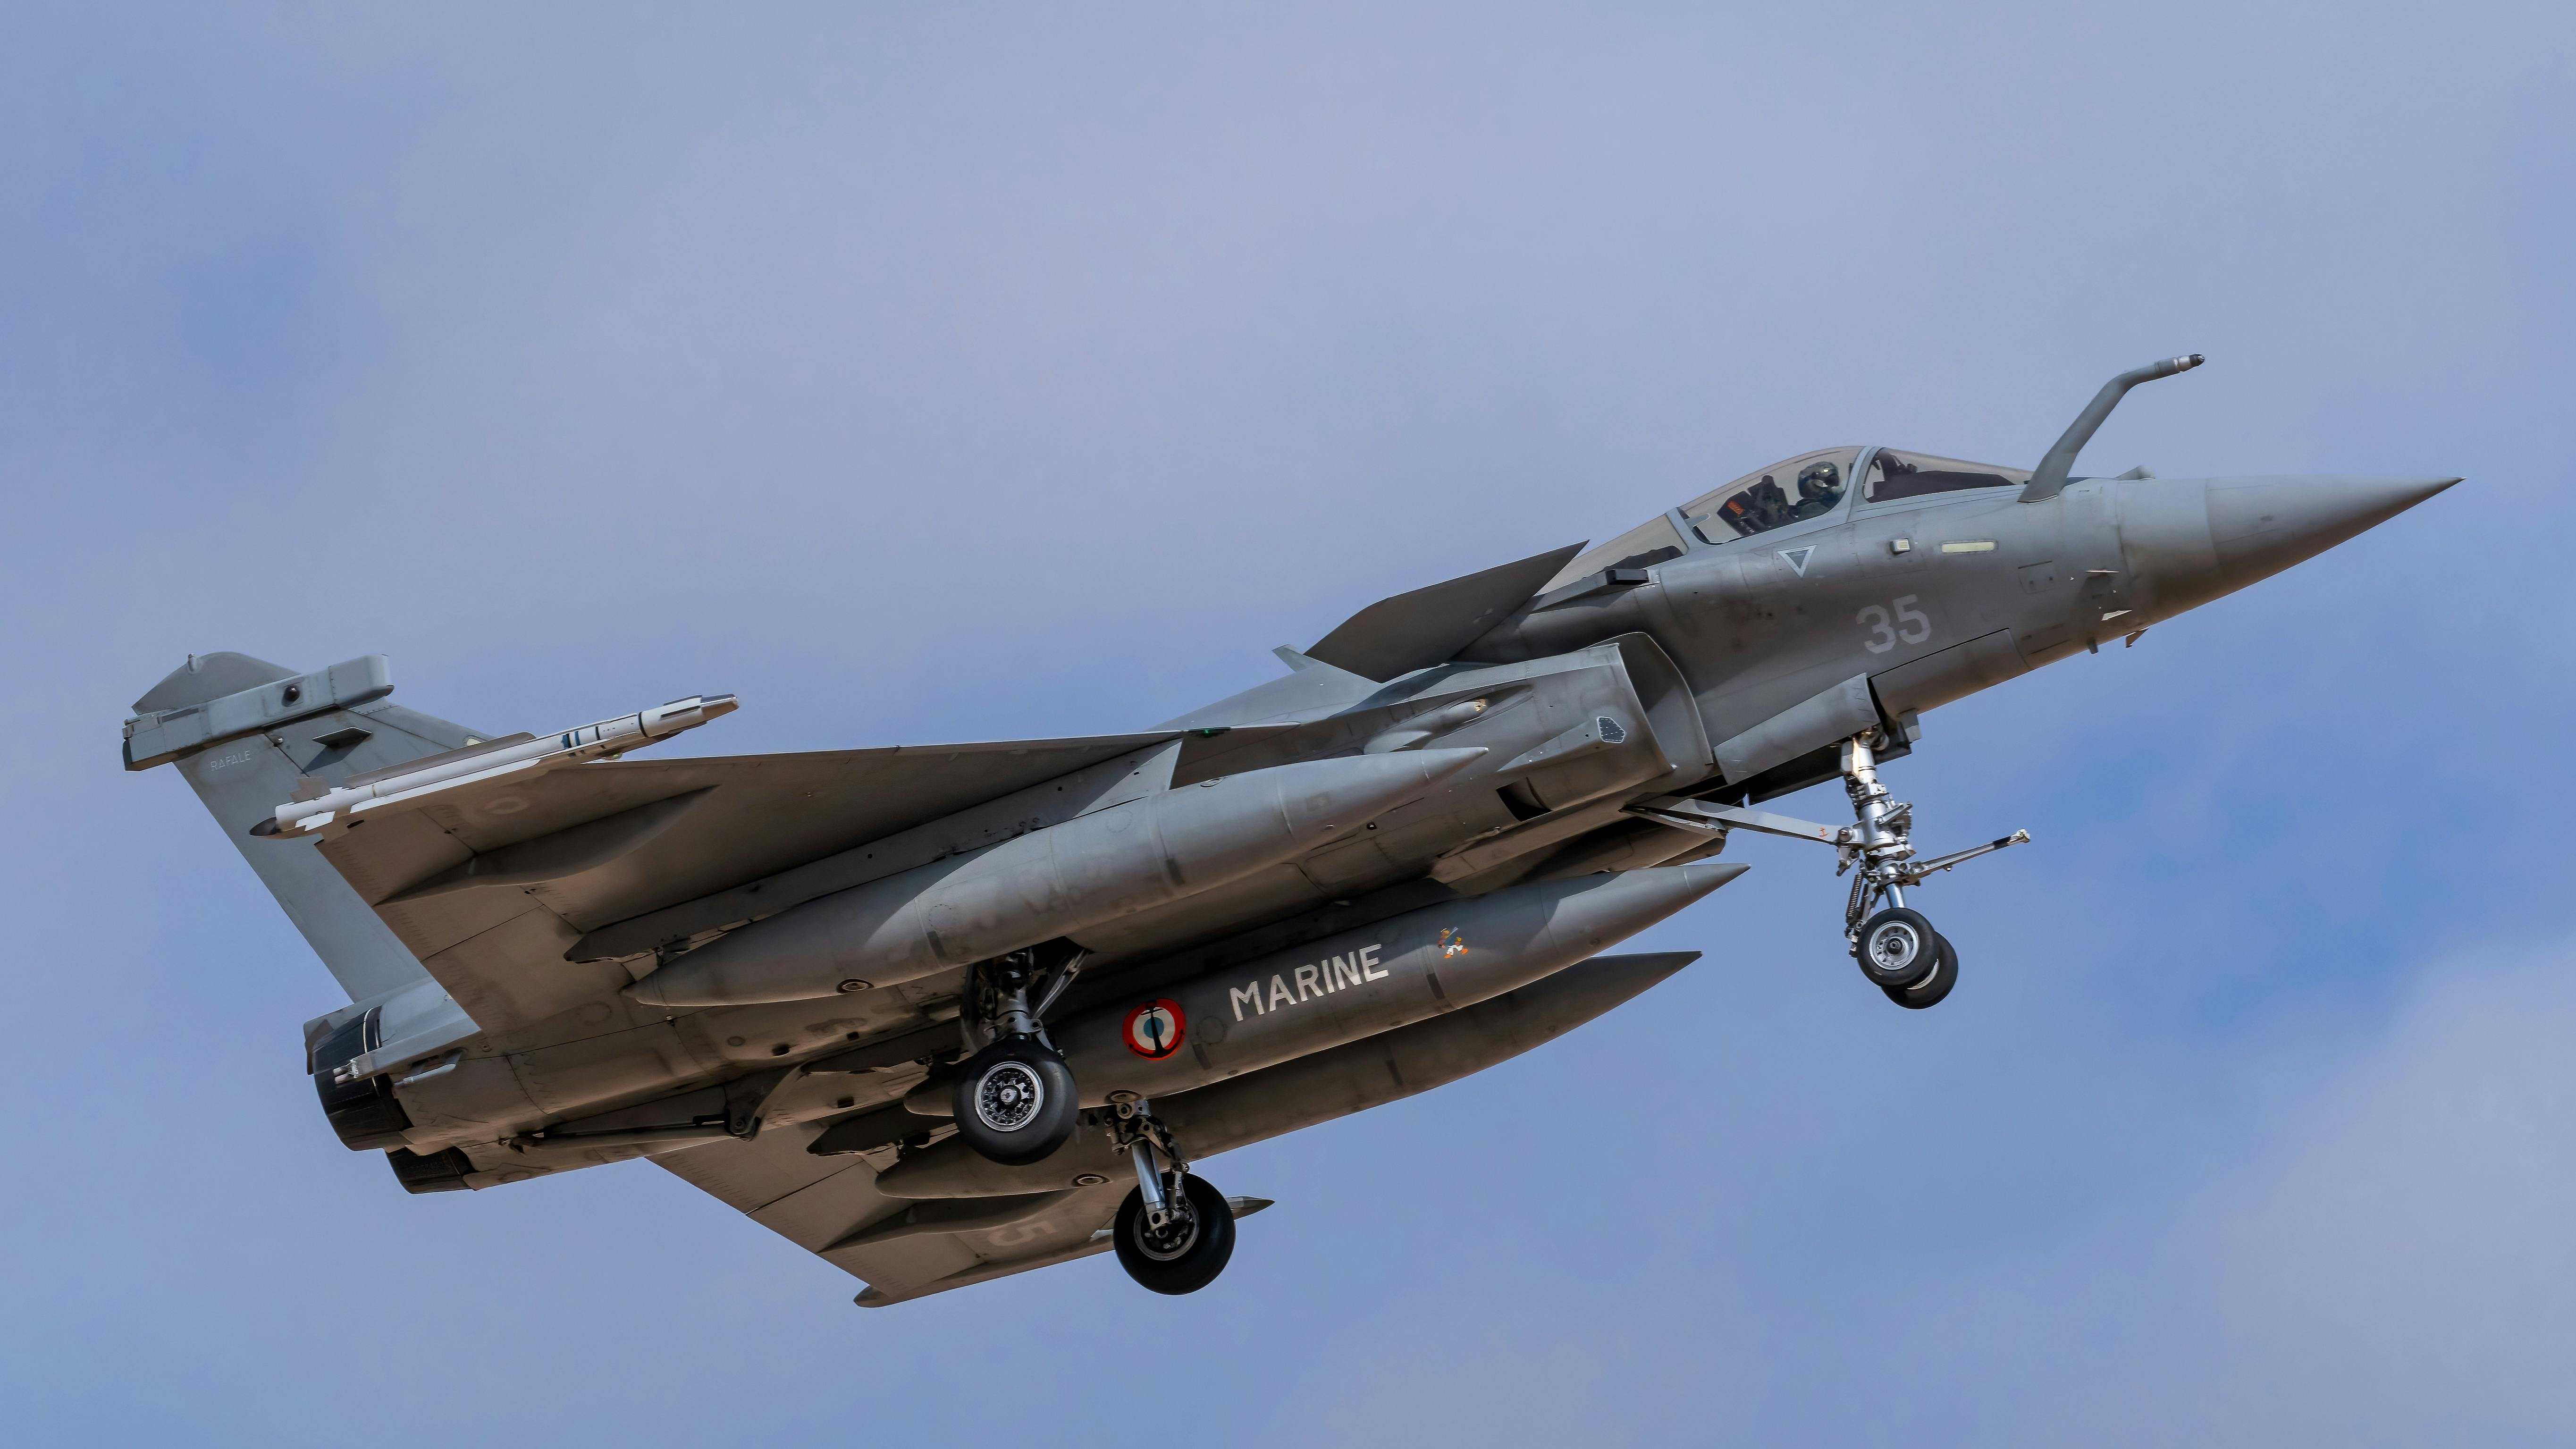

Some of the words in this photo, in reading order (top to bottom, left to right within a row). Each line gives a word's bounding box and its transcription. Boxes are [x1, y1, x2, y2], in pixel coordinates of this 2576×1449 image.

[1856, 594, 1931, 654] 35
[210, 750, 252, 771] RAFALE
[1229, 944, 1389, 1021] MARINE
